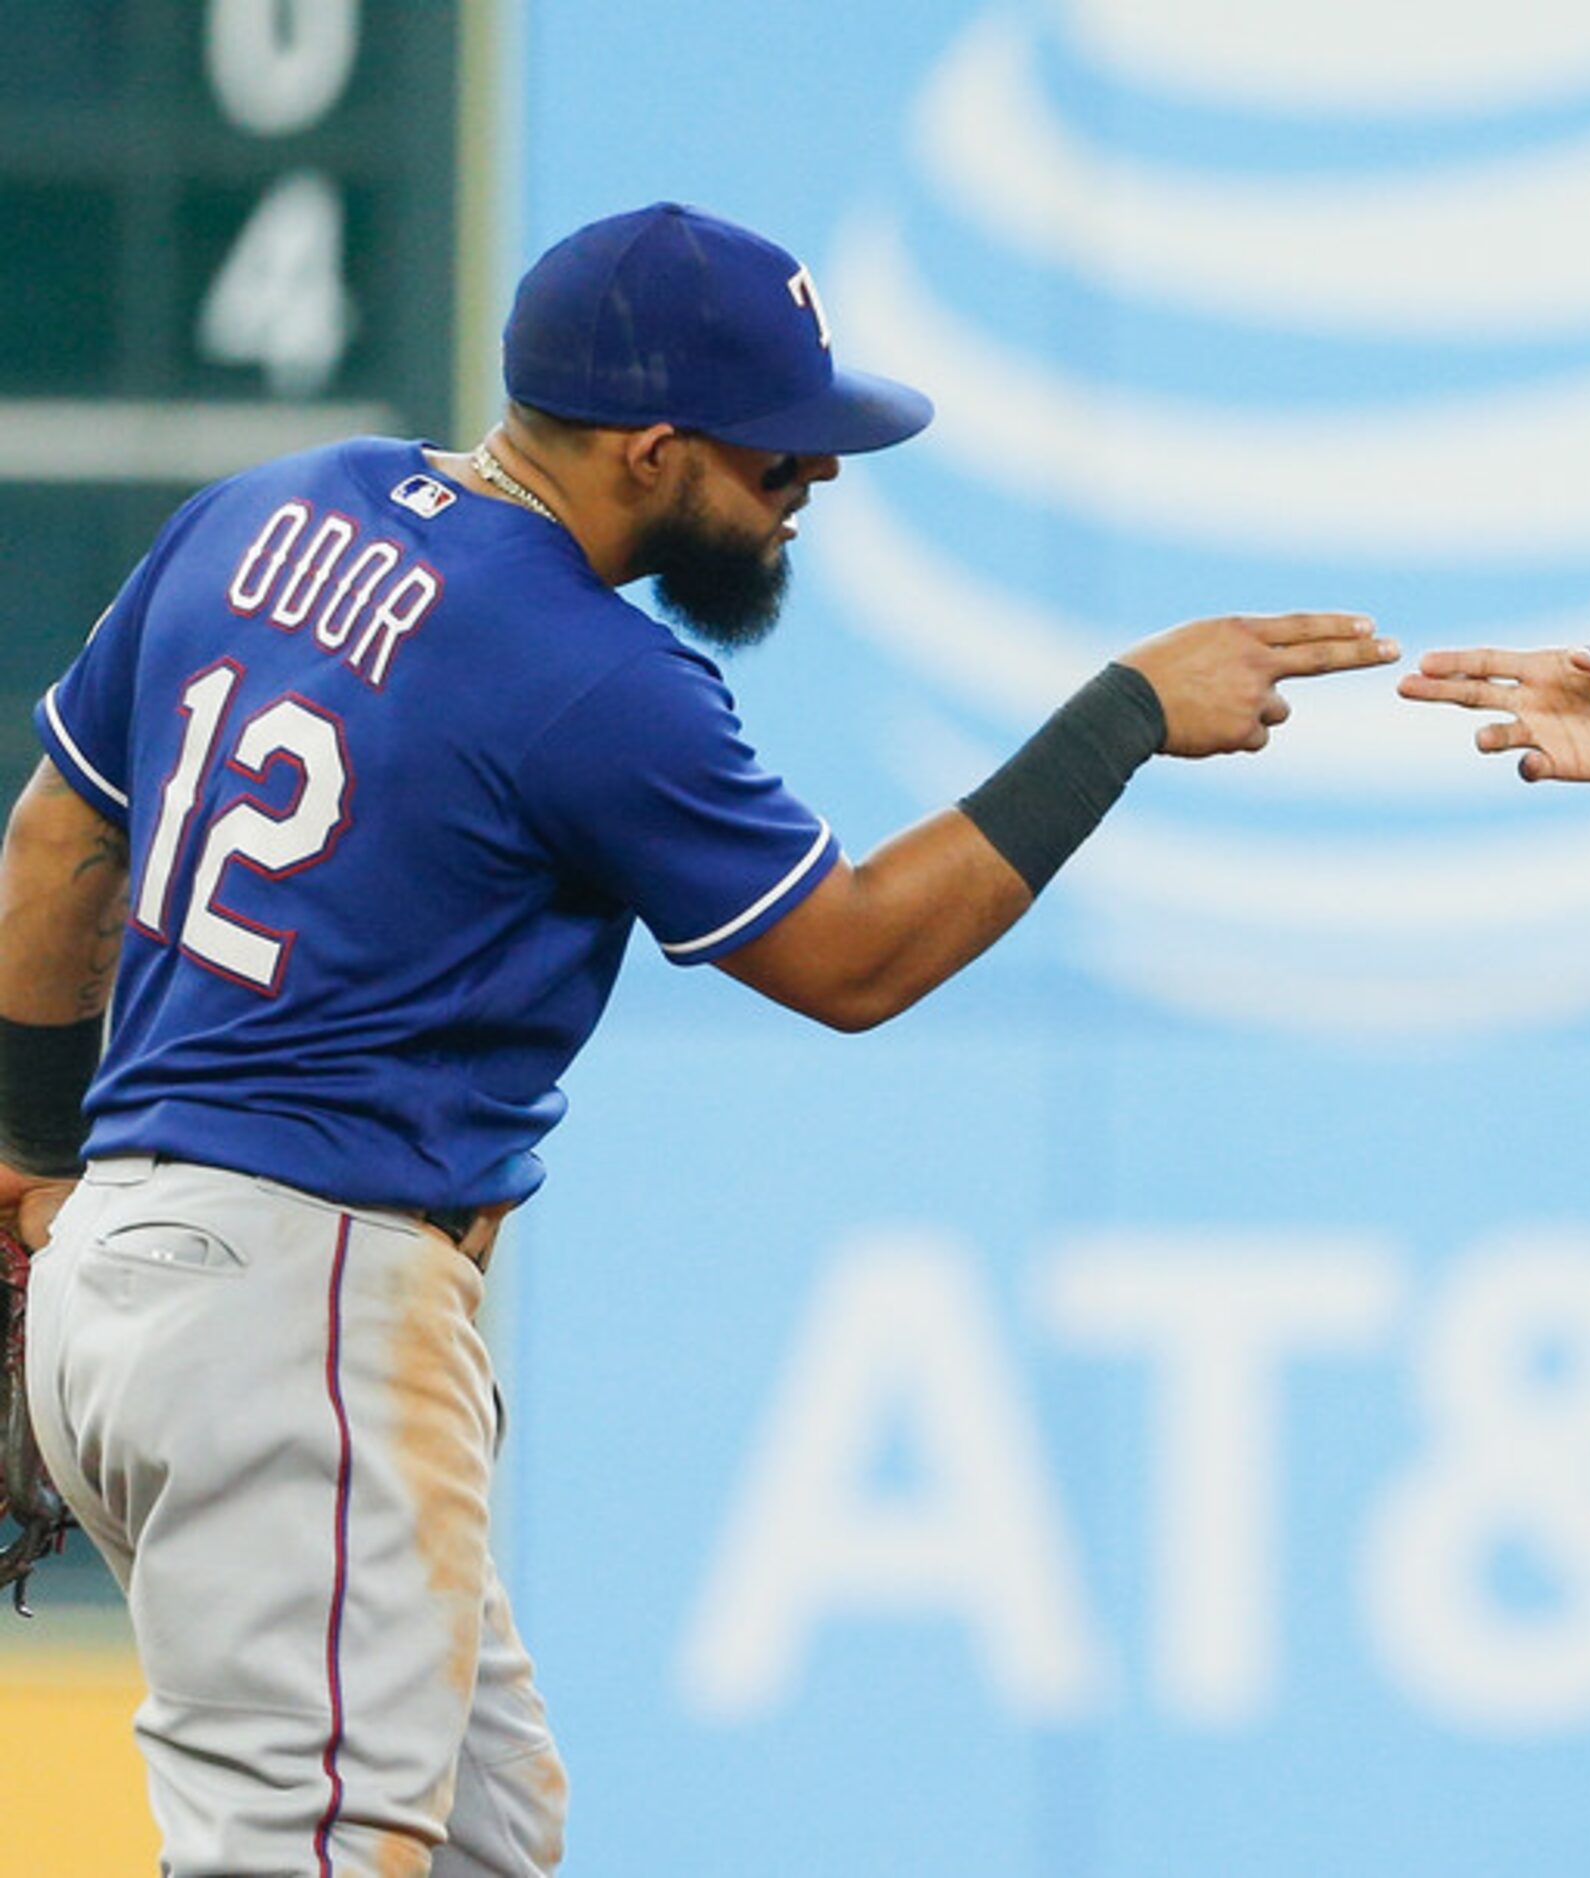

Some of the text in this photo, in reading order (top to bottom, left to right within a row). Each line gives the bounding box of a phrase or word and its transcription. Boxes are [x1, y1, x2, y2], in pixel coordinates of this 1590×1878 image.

[200, 172, 356, 392] 4
[227, 497, 444, 694] ODOR
[130, 657, 355, 997] 12
